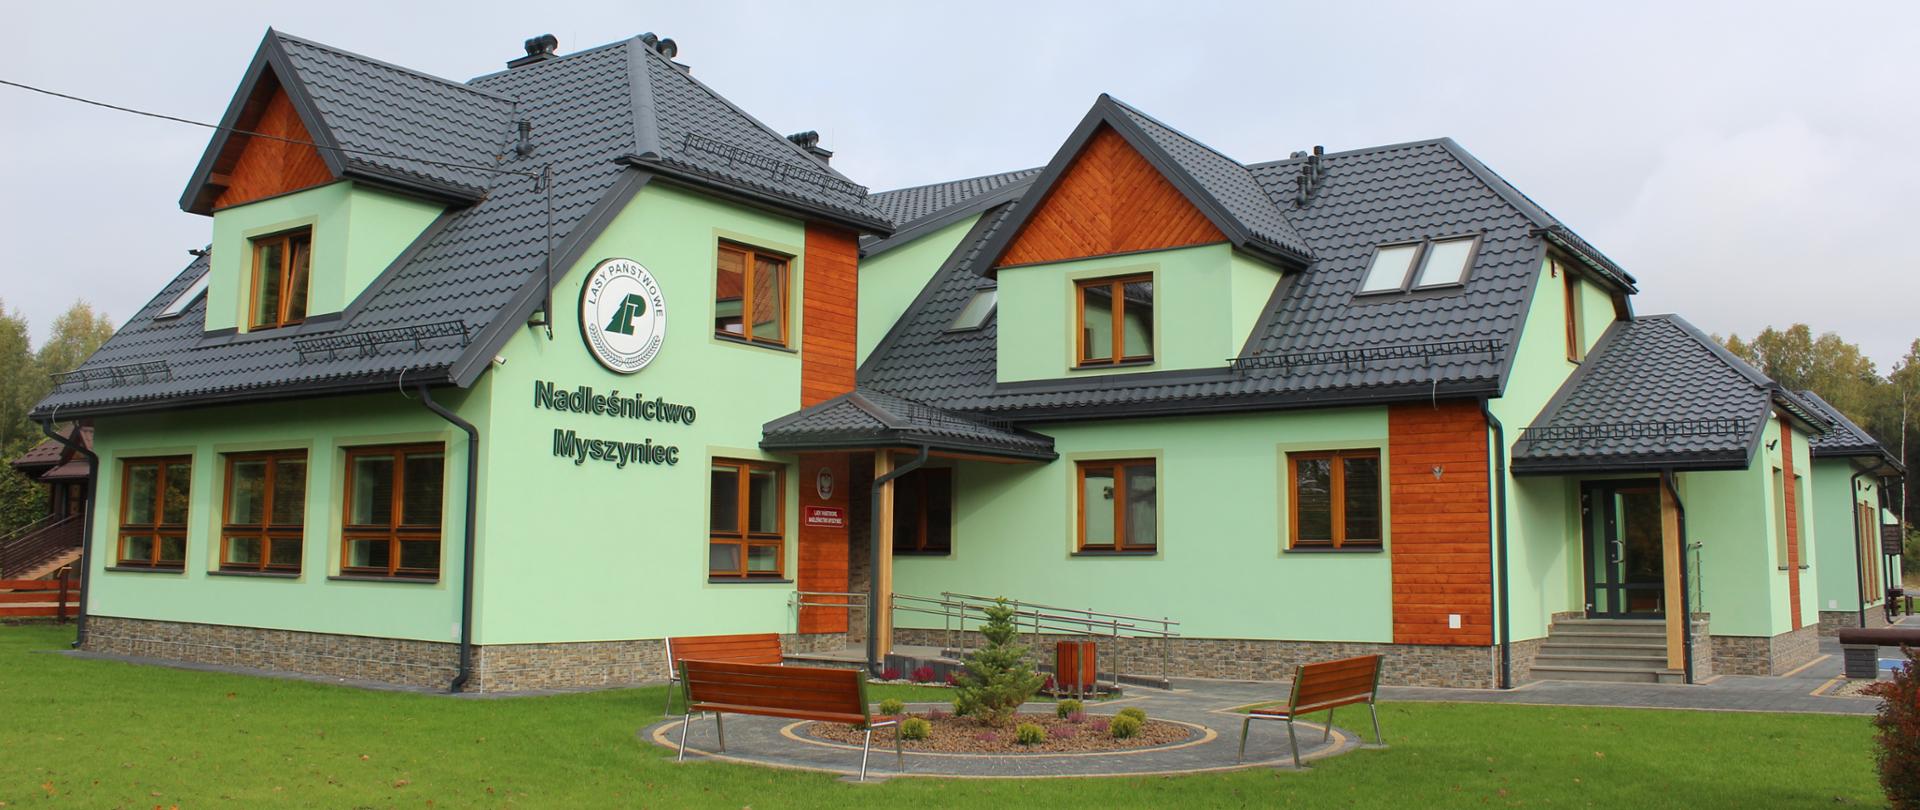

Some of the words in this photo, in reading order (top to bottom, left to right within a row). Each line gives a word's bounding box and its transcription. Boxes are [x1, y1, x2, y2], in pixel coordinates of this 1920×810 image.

[588, 271, 607, 305] LASY
[608, 261, 664, 317] PAŃSTWOWE
[534, 380, 697, 425] Nadleśnictwo
[553, 428, 680, 469] Myszyniec
